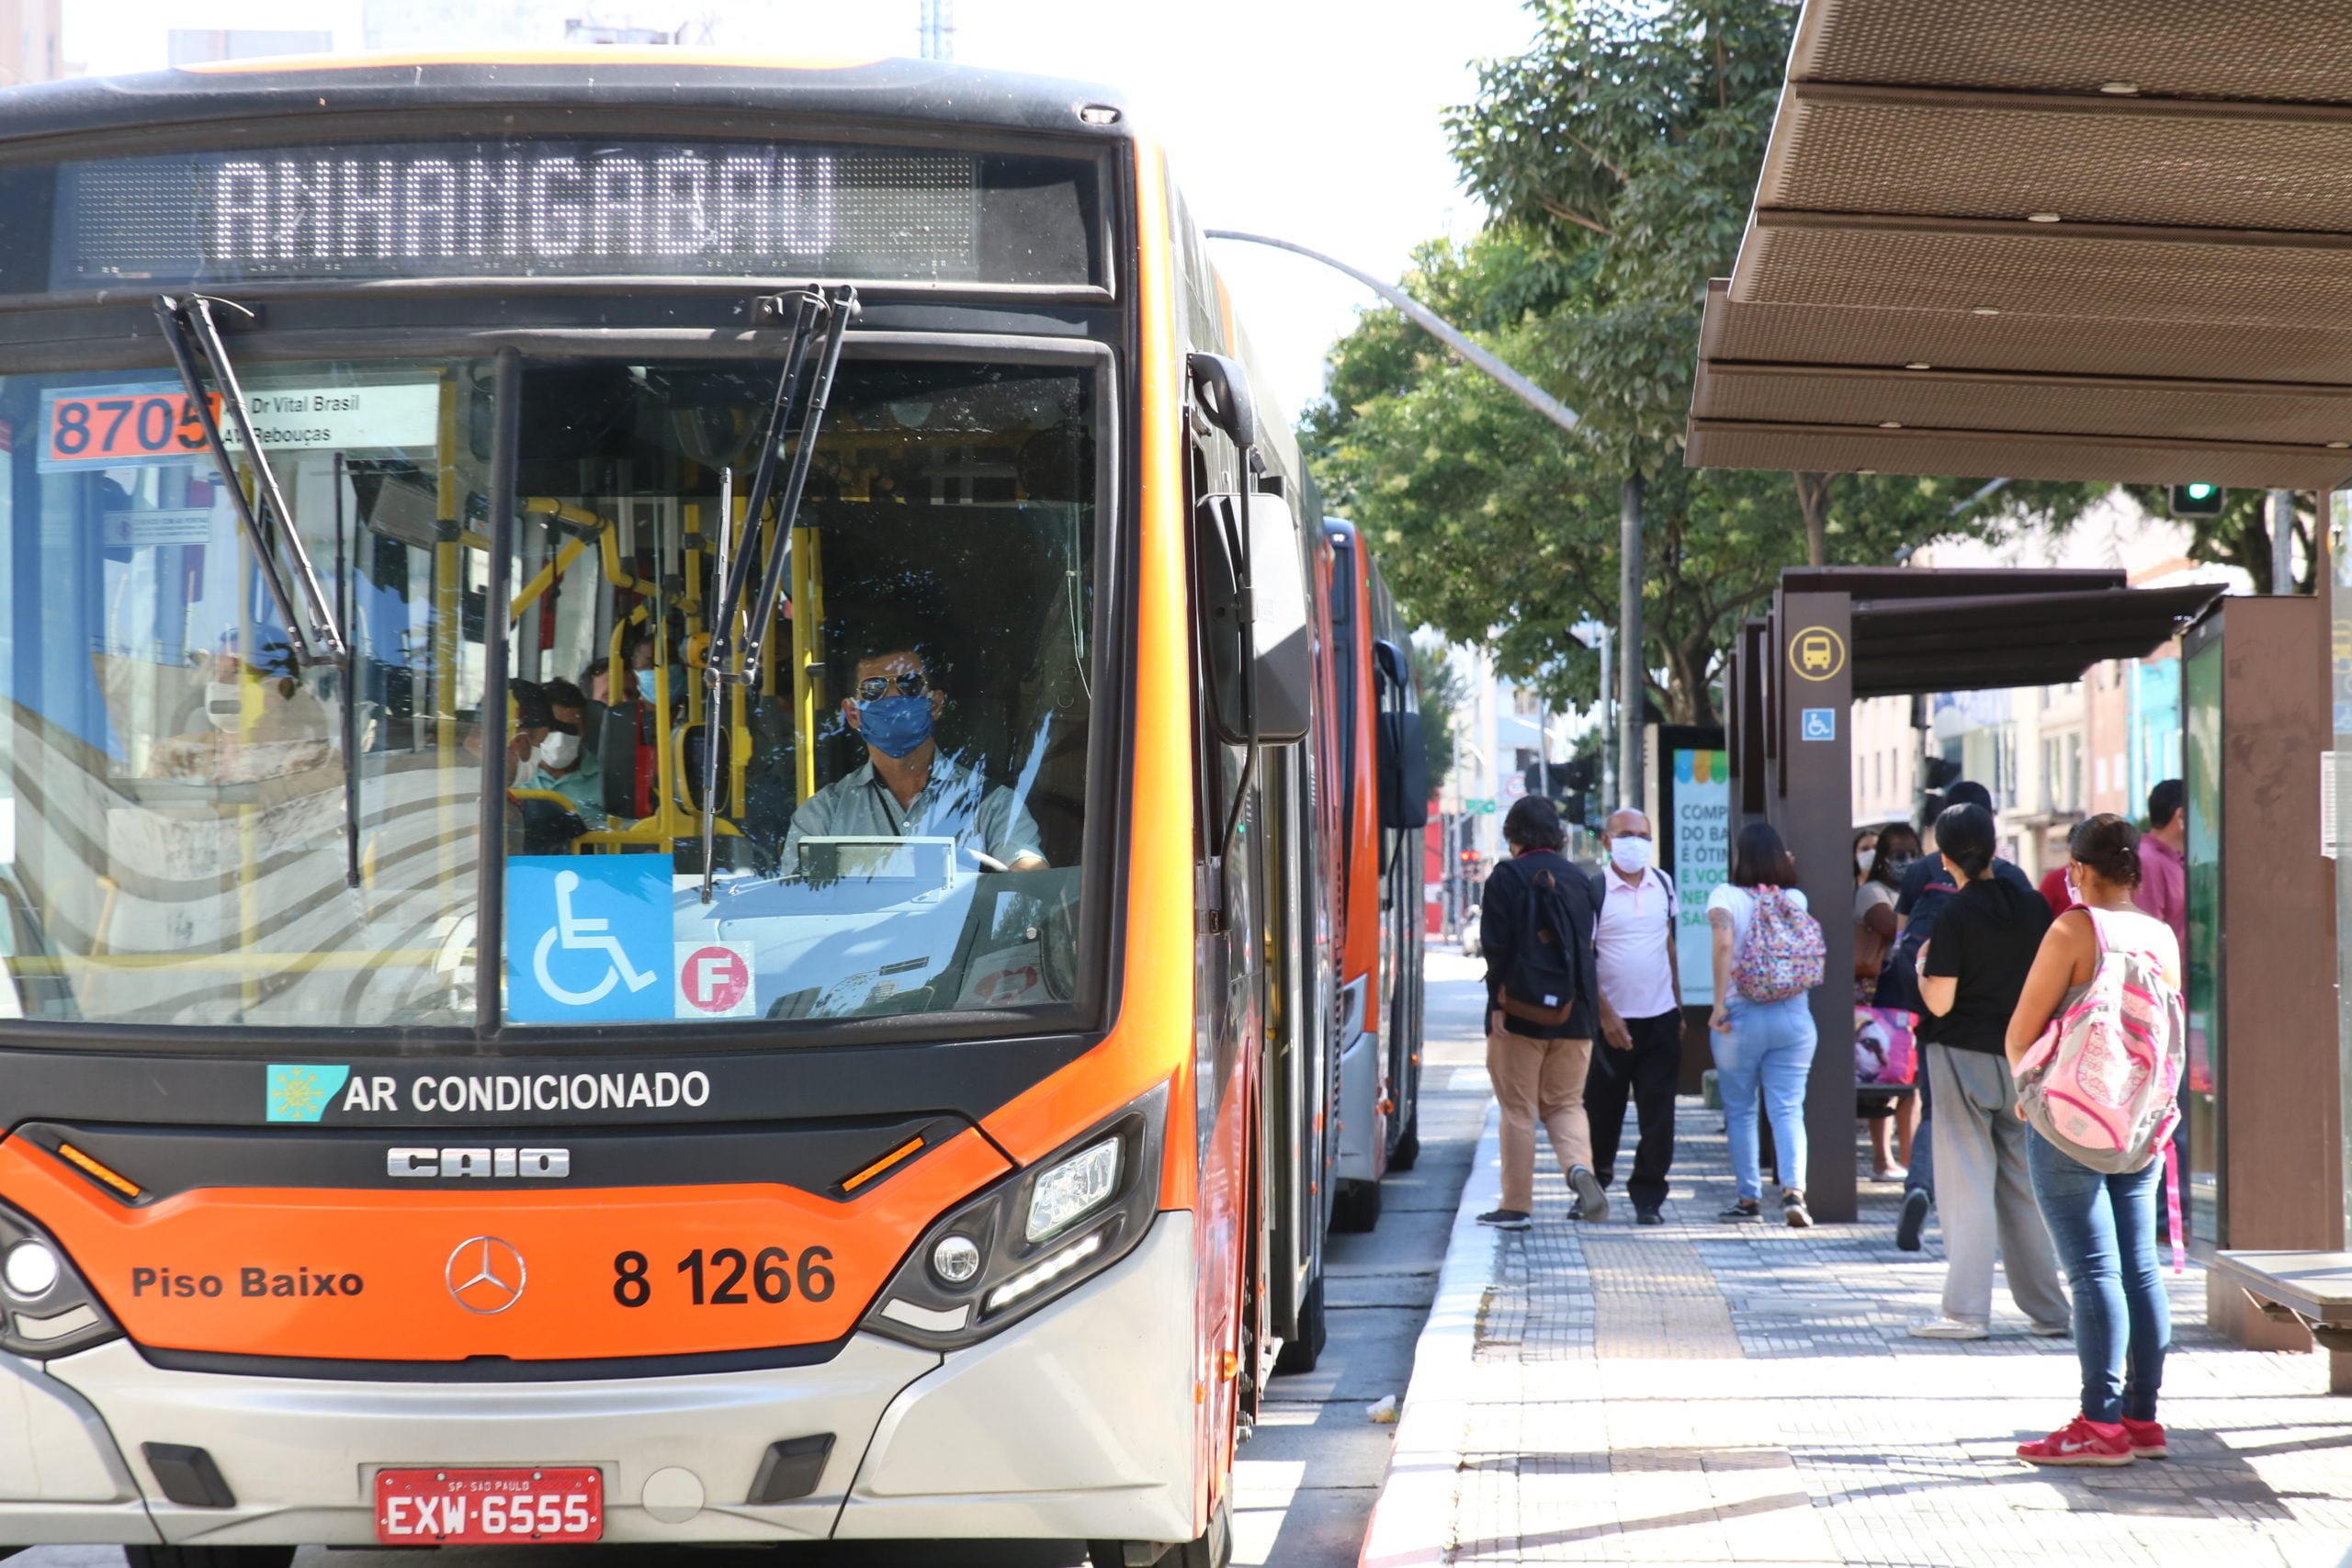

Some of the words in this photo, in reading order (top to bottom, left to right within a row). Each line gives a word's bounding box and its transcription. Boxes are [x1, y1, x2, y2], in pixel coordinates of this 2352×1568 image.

[216, 156, 831, 259] ANHANGABAU
[252, 398, 269, 413] Dr
[274, 397, 309, 413] Vital
[313, 395, 359, 412] Brasil
[55, 397, 214, 455] 8705
[253, 427, 331, 446] Rebouças
[1681, 826, 1704, 841] DO
[697, 958, 732, 1002] F
[343, 1076, 398, 1111] AR
[412, 1070, 710, 1112] CONDICIONADO
[387, 1146, 571, 1178] CAIO
[131, 1267, 223, 1298] Piso
[240, 1266, 364, 1298] Baixo
[613, 1250, 651, 1308] 8
[677, 1245, 836, 1305] 1266
[494, 1480, 530, 1492] PAULO
